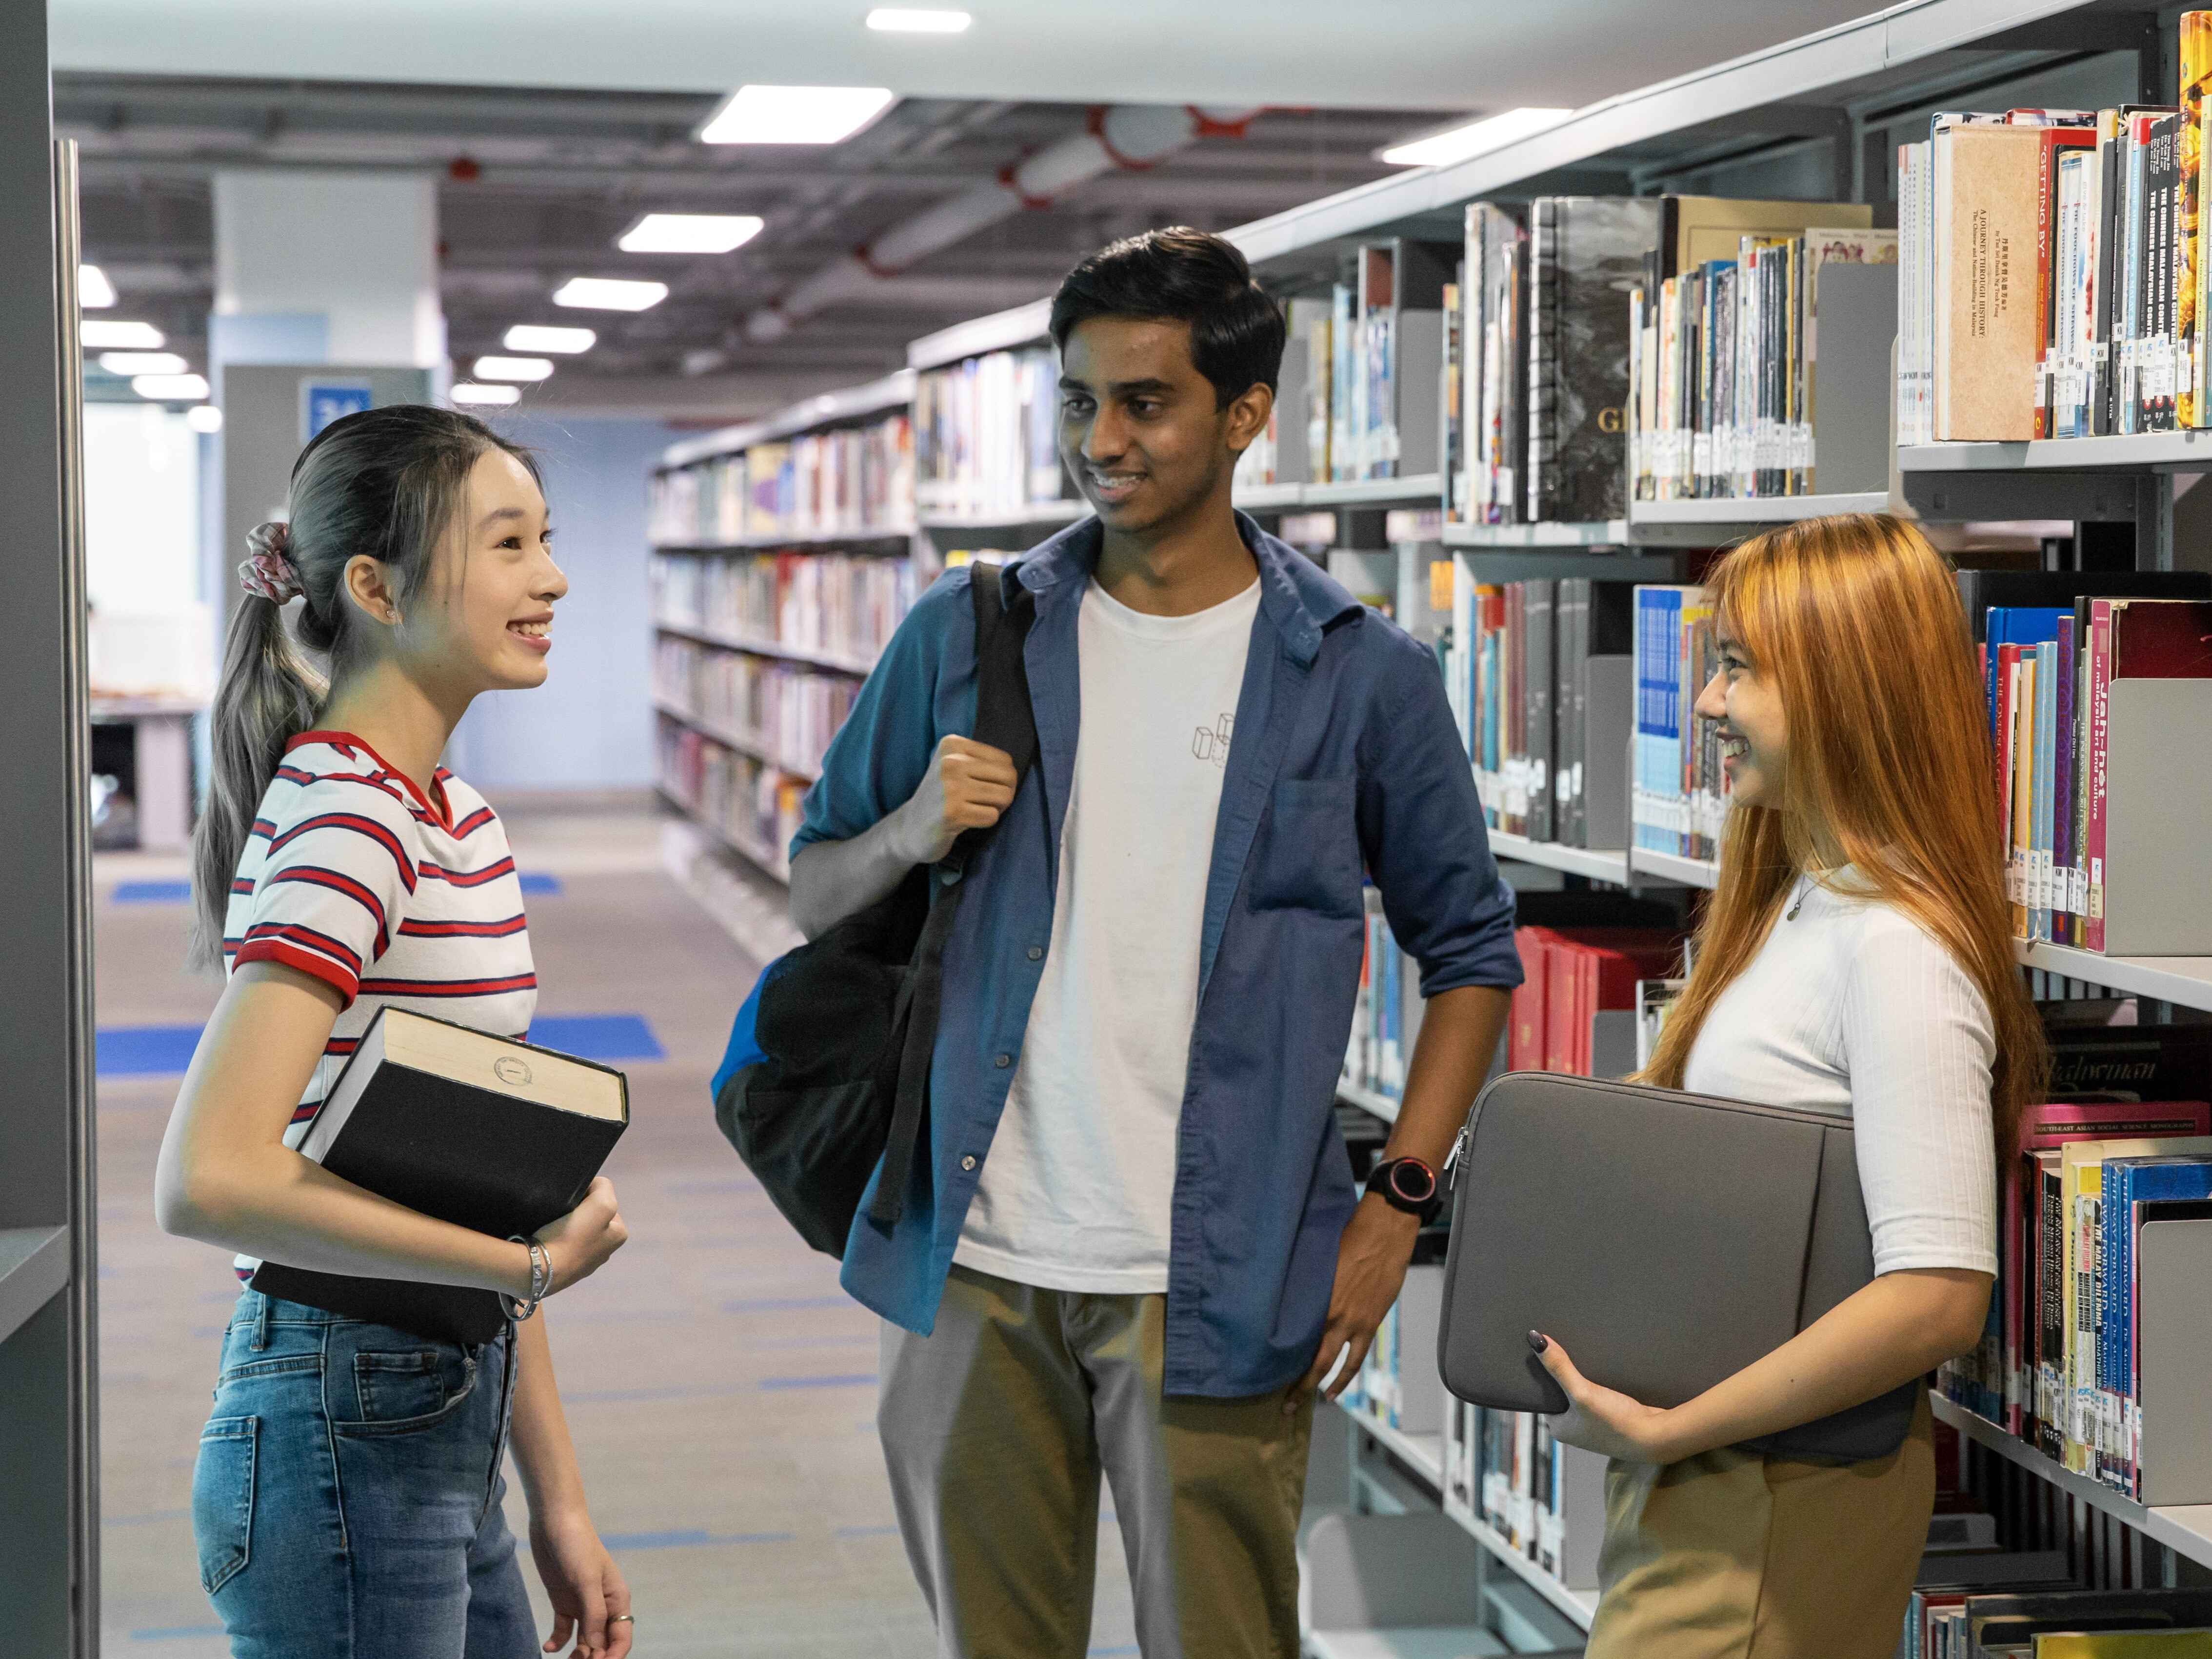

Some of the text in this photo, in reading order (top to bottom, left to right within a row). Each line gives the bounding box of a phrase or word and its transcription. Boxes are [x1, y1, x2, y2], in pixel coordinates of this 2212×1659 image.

[1994, 279, 2000, 287] Ng
[2097, 349, 2104, 358] KM
[2096, 656, 2101, 668] of
